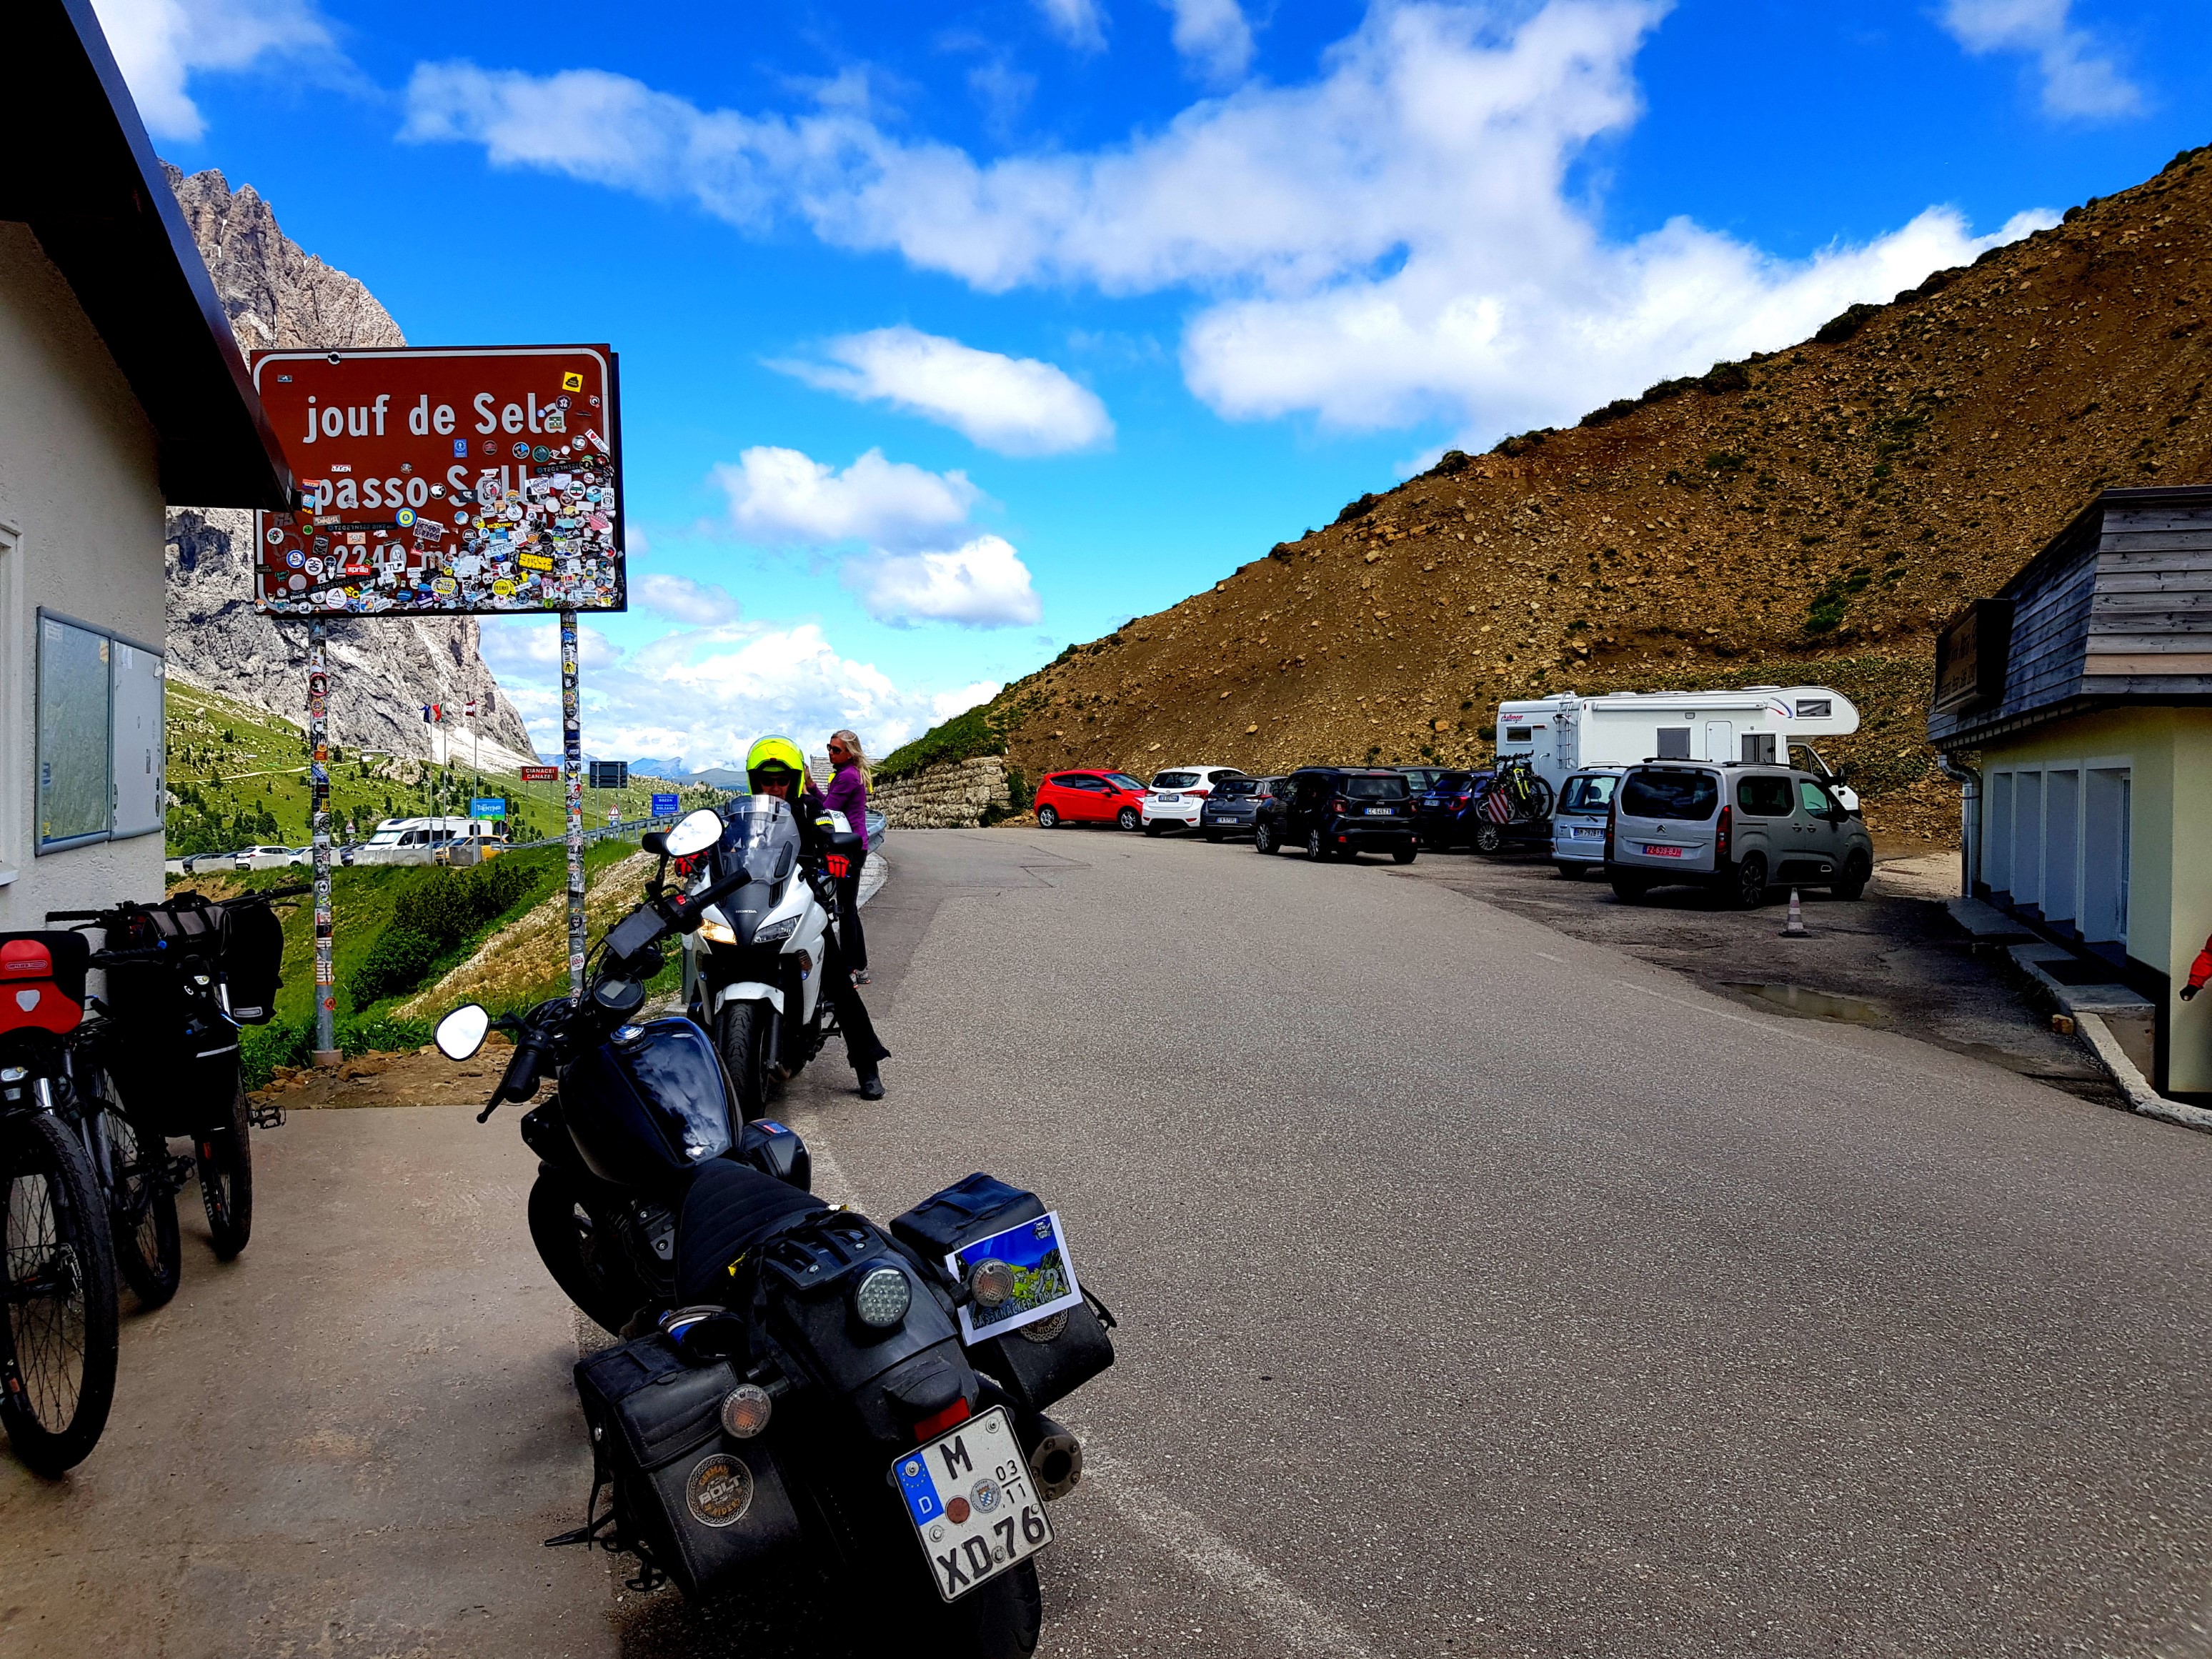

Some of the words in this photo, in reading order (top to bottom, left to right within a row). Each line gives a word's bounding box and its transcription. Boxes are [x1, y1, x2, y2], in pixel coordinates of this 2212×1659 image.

[302, 394, 391, 444] jouf
[409, 394, 455, 436] de
[474, 393, 567, 434] Sela
[315, 477, 429, 515] passo
[1037, 1315, 1060, 1334] RIDERS
[940, 1435, 972, 1480] M
[995, 1460, 1017, 1480] 03
[698, 1475, 741, 1505] BOLT
[918, 1495, 932, 1514] D
[1006, 1483, 1026, 1503] 11
[937, 1535, 993, 1594] XD
[993, 1505, 1045, 1559] 76
